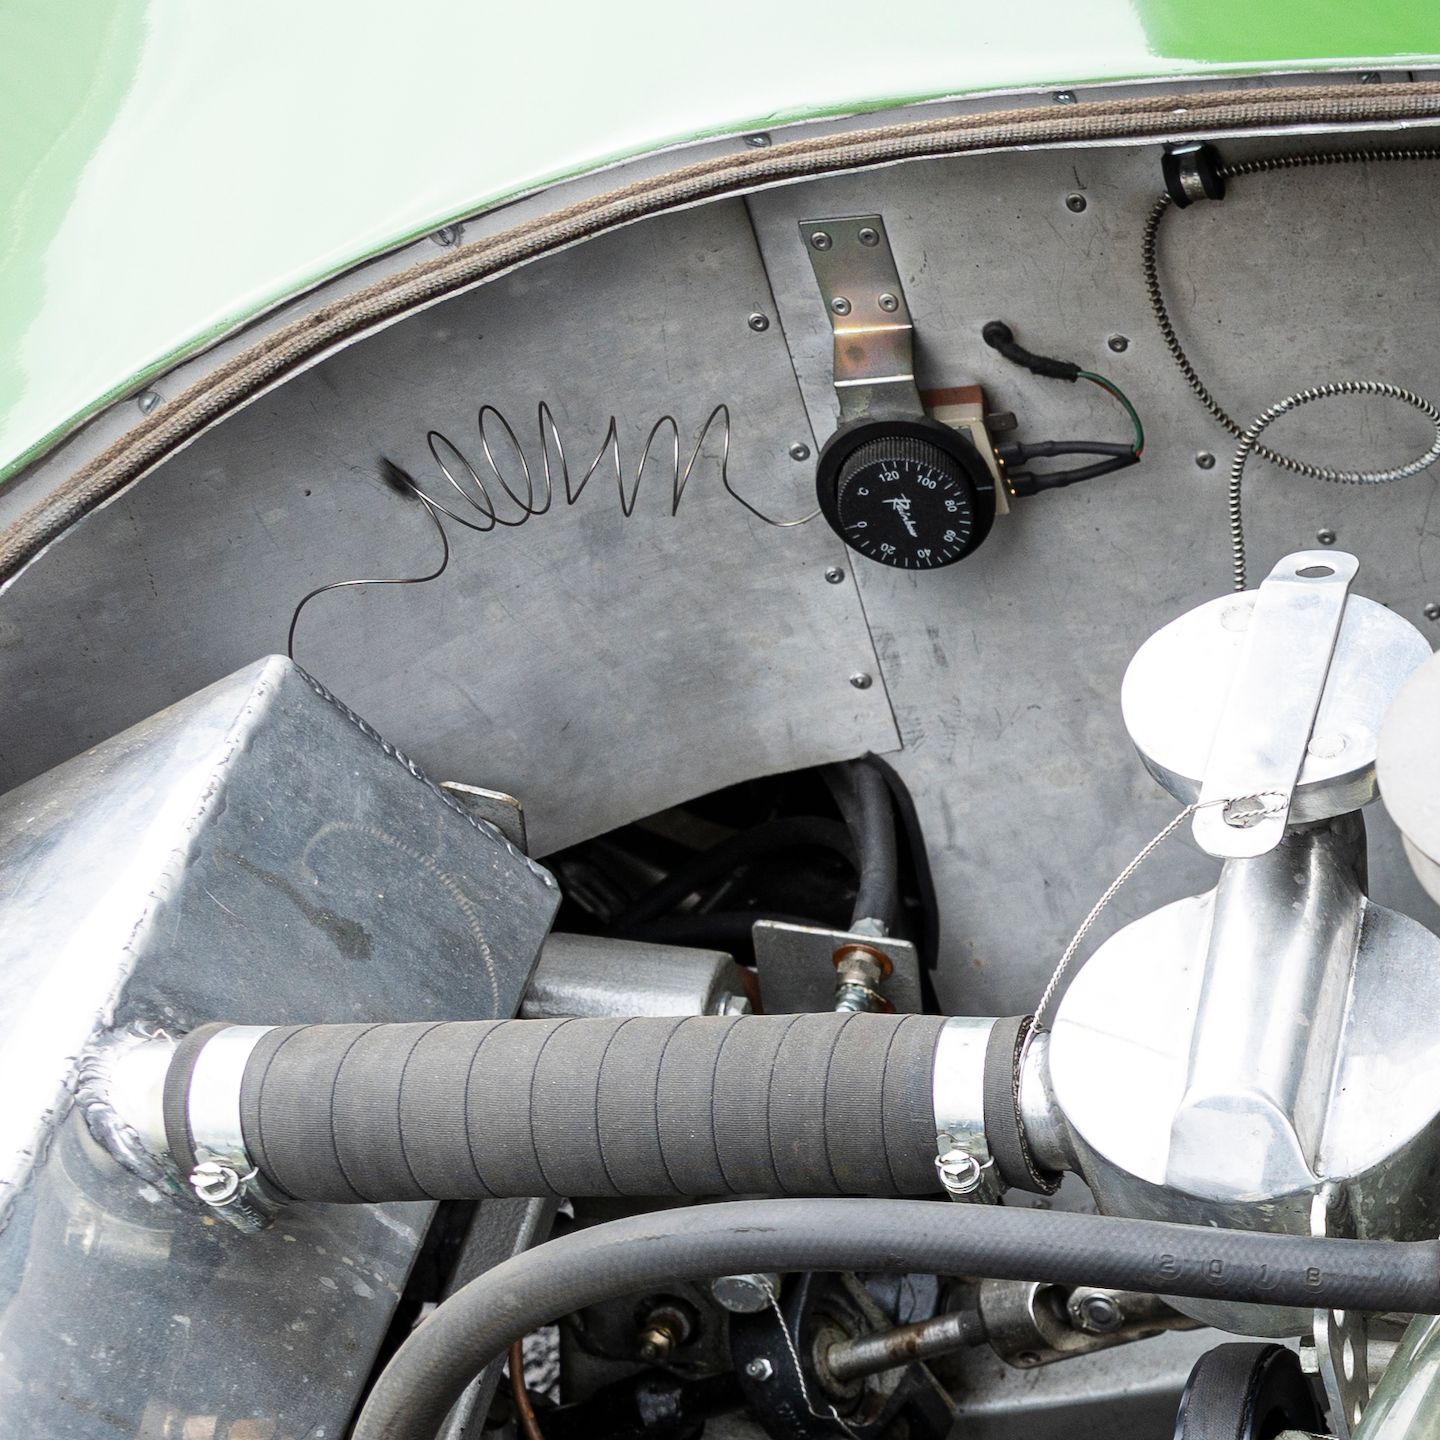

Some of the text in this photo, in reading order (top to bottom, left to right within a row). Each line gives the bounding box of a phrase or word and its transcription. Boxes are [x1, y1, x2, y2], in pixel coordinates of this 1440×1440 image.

[878, 470, 900, 483] 120
[916, 474, 937, 490] 100
[944, 499, 958, 513] 80
